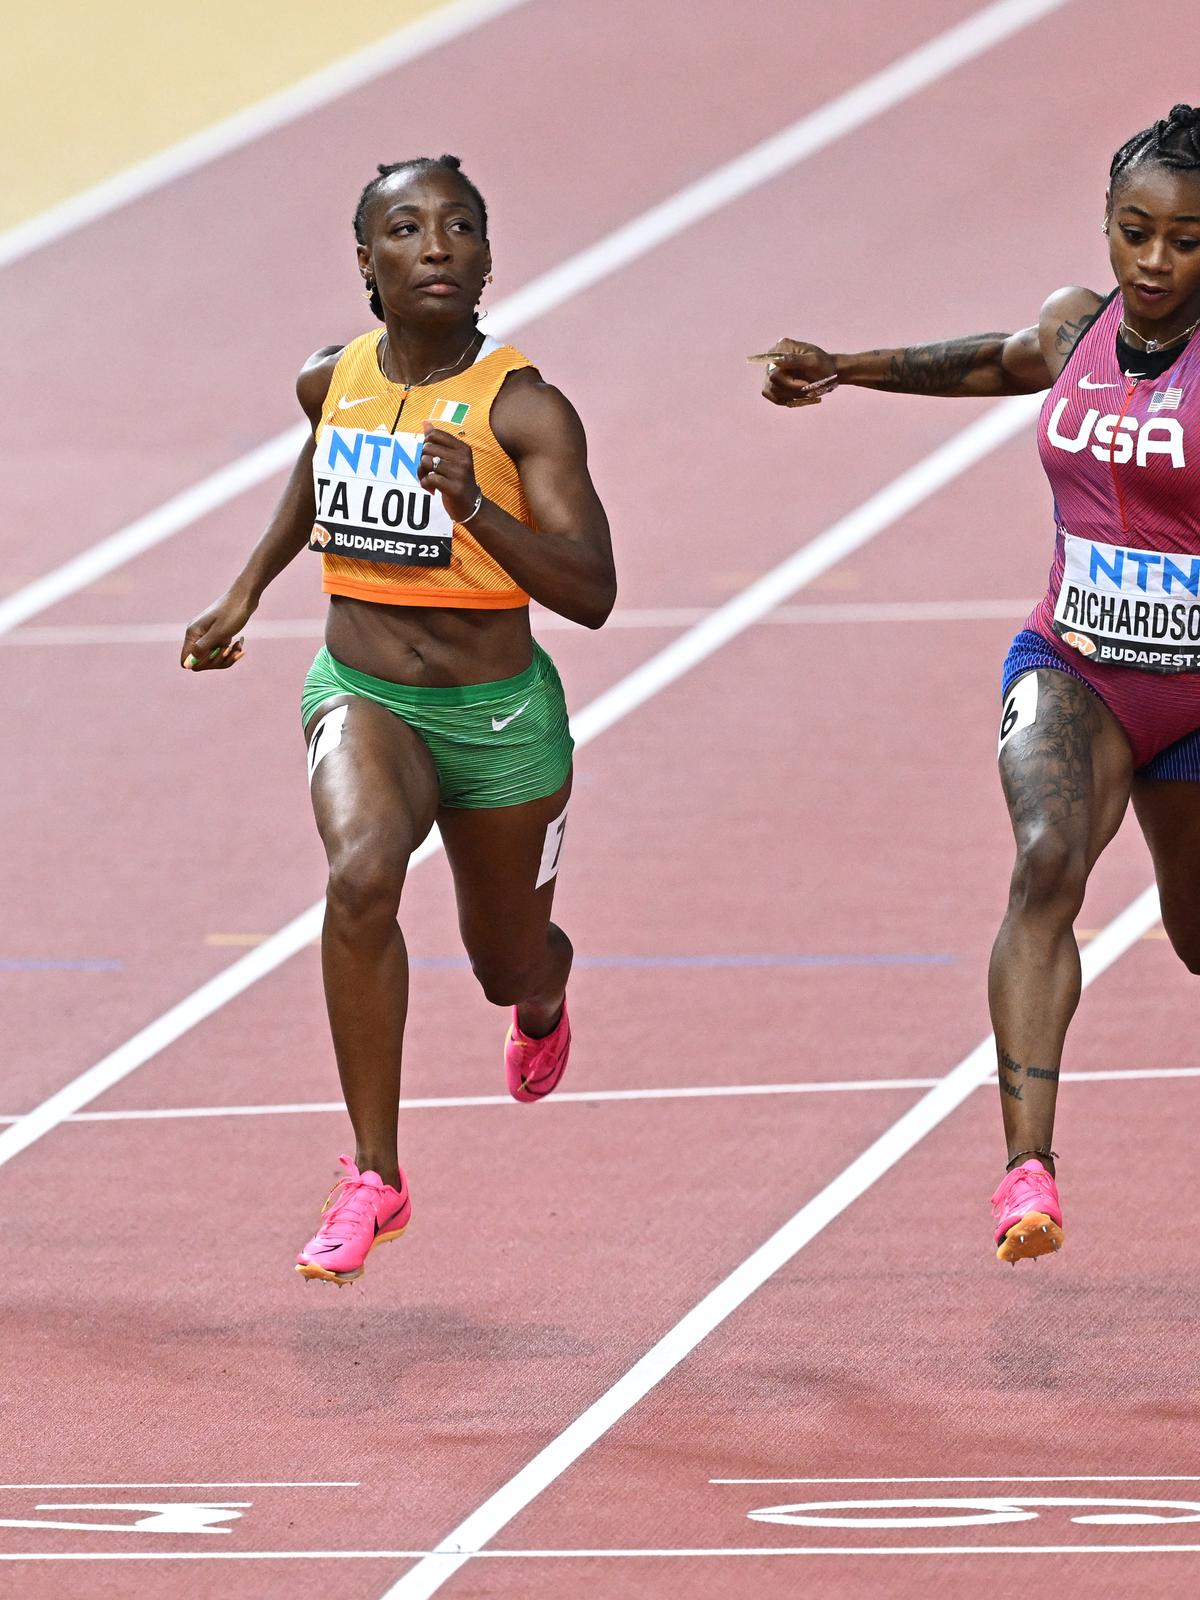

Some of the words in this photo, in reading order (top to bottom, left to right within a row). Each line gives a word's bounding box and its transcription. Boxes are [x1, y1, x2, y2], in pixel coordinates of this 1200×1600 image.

[327, 429, 423, 484] NTN
[1047, 397, 1185, 469] USA
[317, 478, 349, 520] TA
[361, 486, 431, 531] LOU
[334, 532, 416, 555] BUDAPEST
[418, 544, 440, 558] 23
[1089, 543, 1200, 598] NTN
[1100, 645, 1195, 666] BUDAPEST
[1000, 697, 1018, 741] 6
